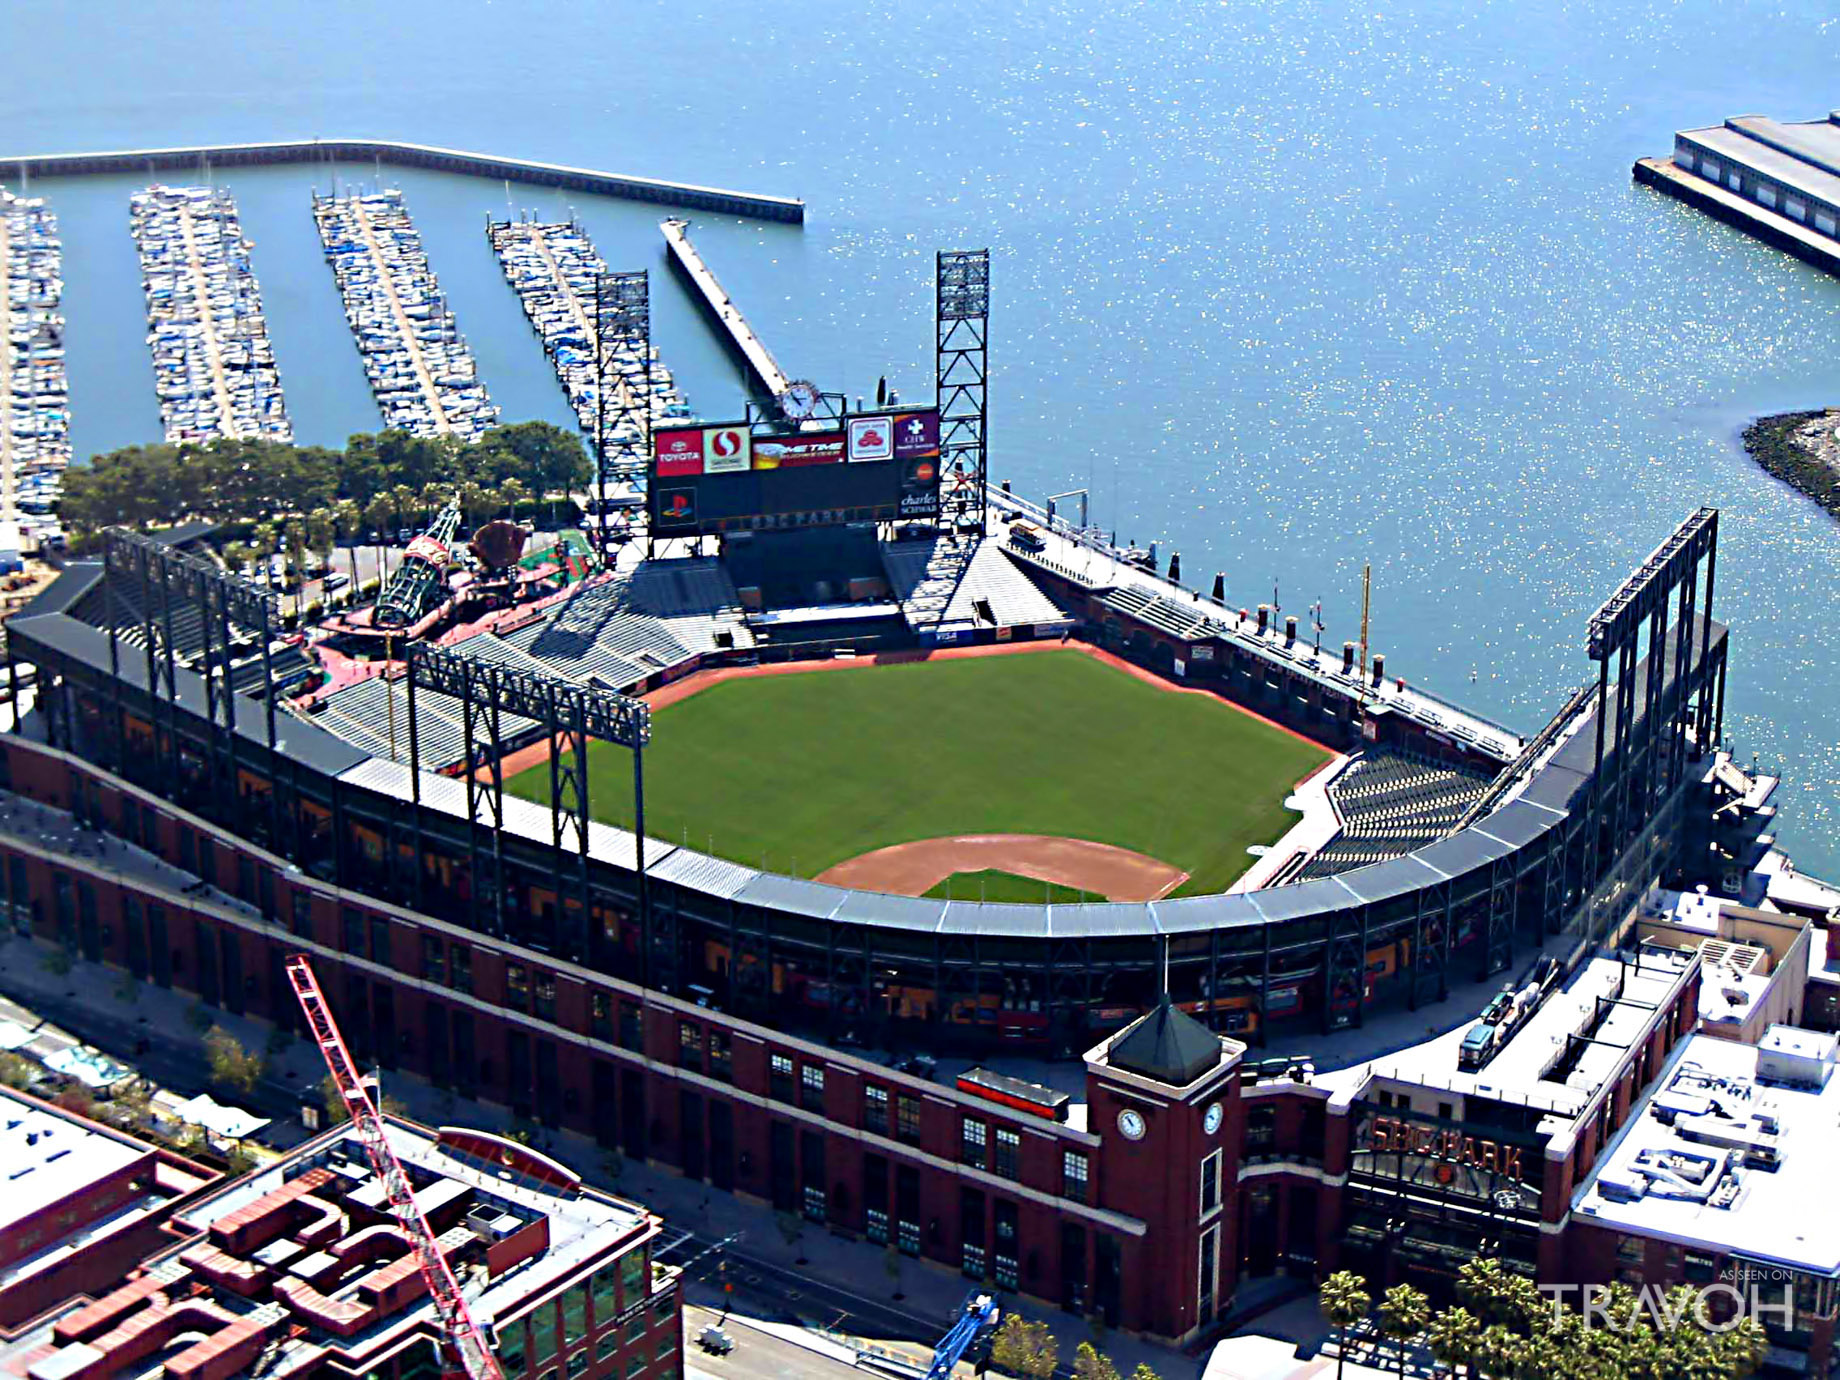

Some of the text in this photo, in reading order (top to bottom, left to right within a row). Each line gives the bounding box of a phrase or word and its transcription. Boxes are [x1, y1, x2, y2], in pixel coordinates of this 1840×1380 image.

[810, 441, 844, 451] TIME
[658, 452, 700, 462] TOYOTA
[901, 494, 937, 505] charles
[795, 510, 845, 525] PARK
[1371, 1118, 1523, 1181] SBC PARK
